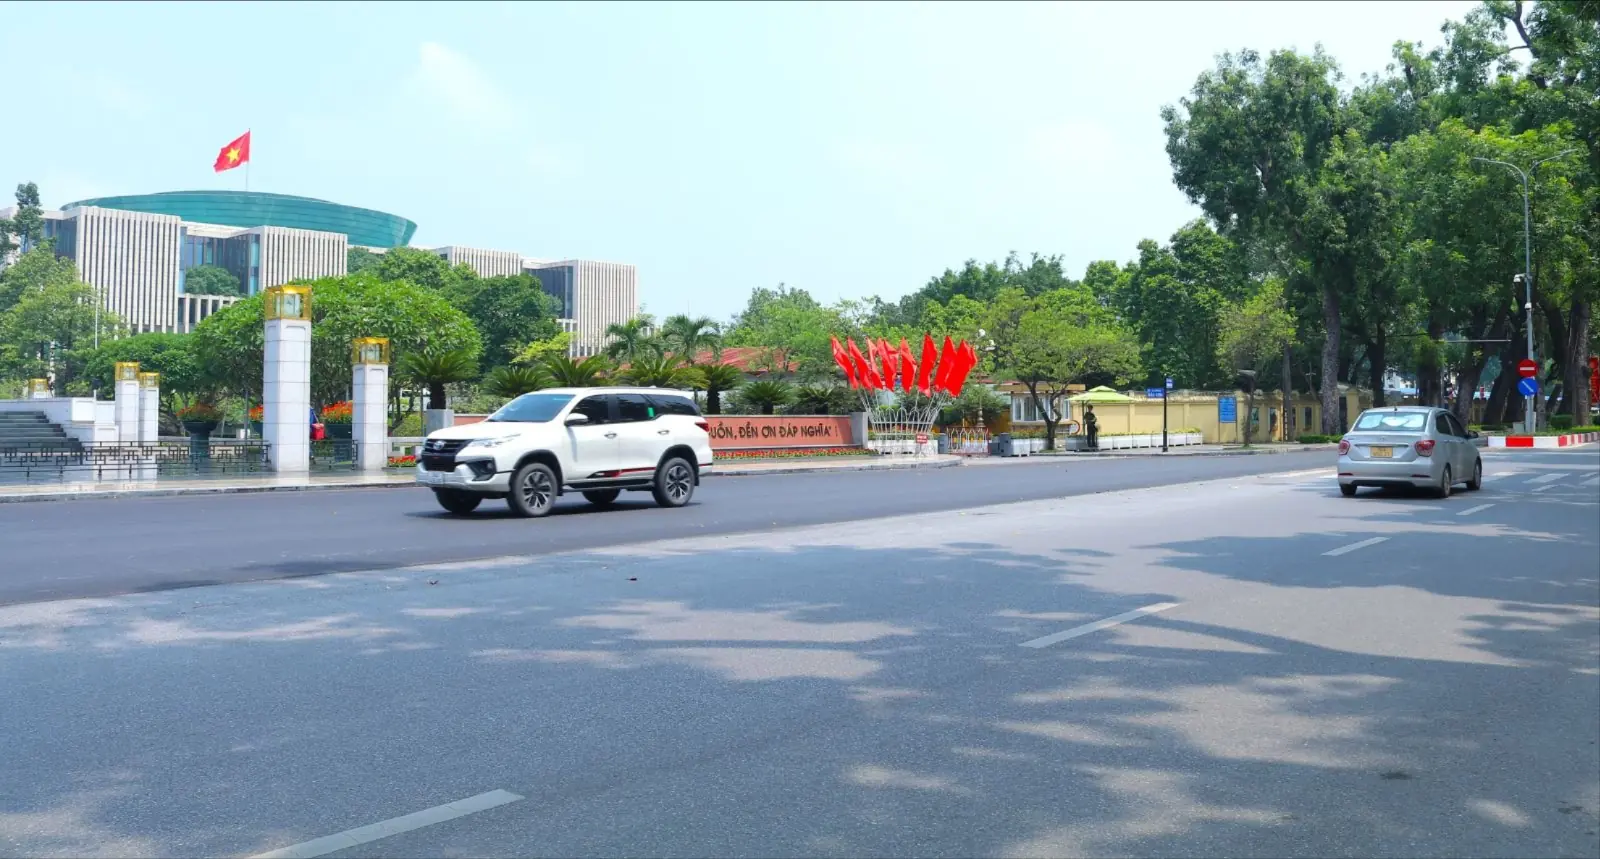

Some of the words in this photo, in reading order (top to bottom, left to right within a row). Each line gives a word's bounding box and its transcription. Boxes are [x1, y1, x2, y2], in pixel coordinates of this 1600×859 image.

[739, 421, 758, 438] ĐỀN
[762, 425, 776, 438] ƠN
[779, 422, 798, 438] ĐÁP
